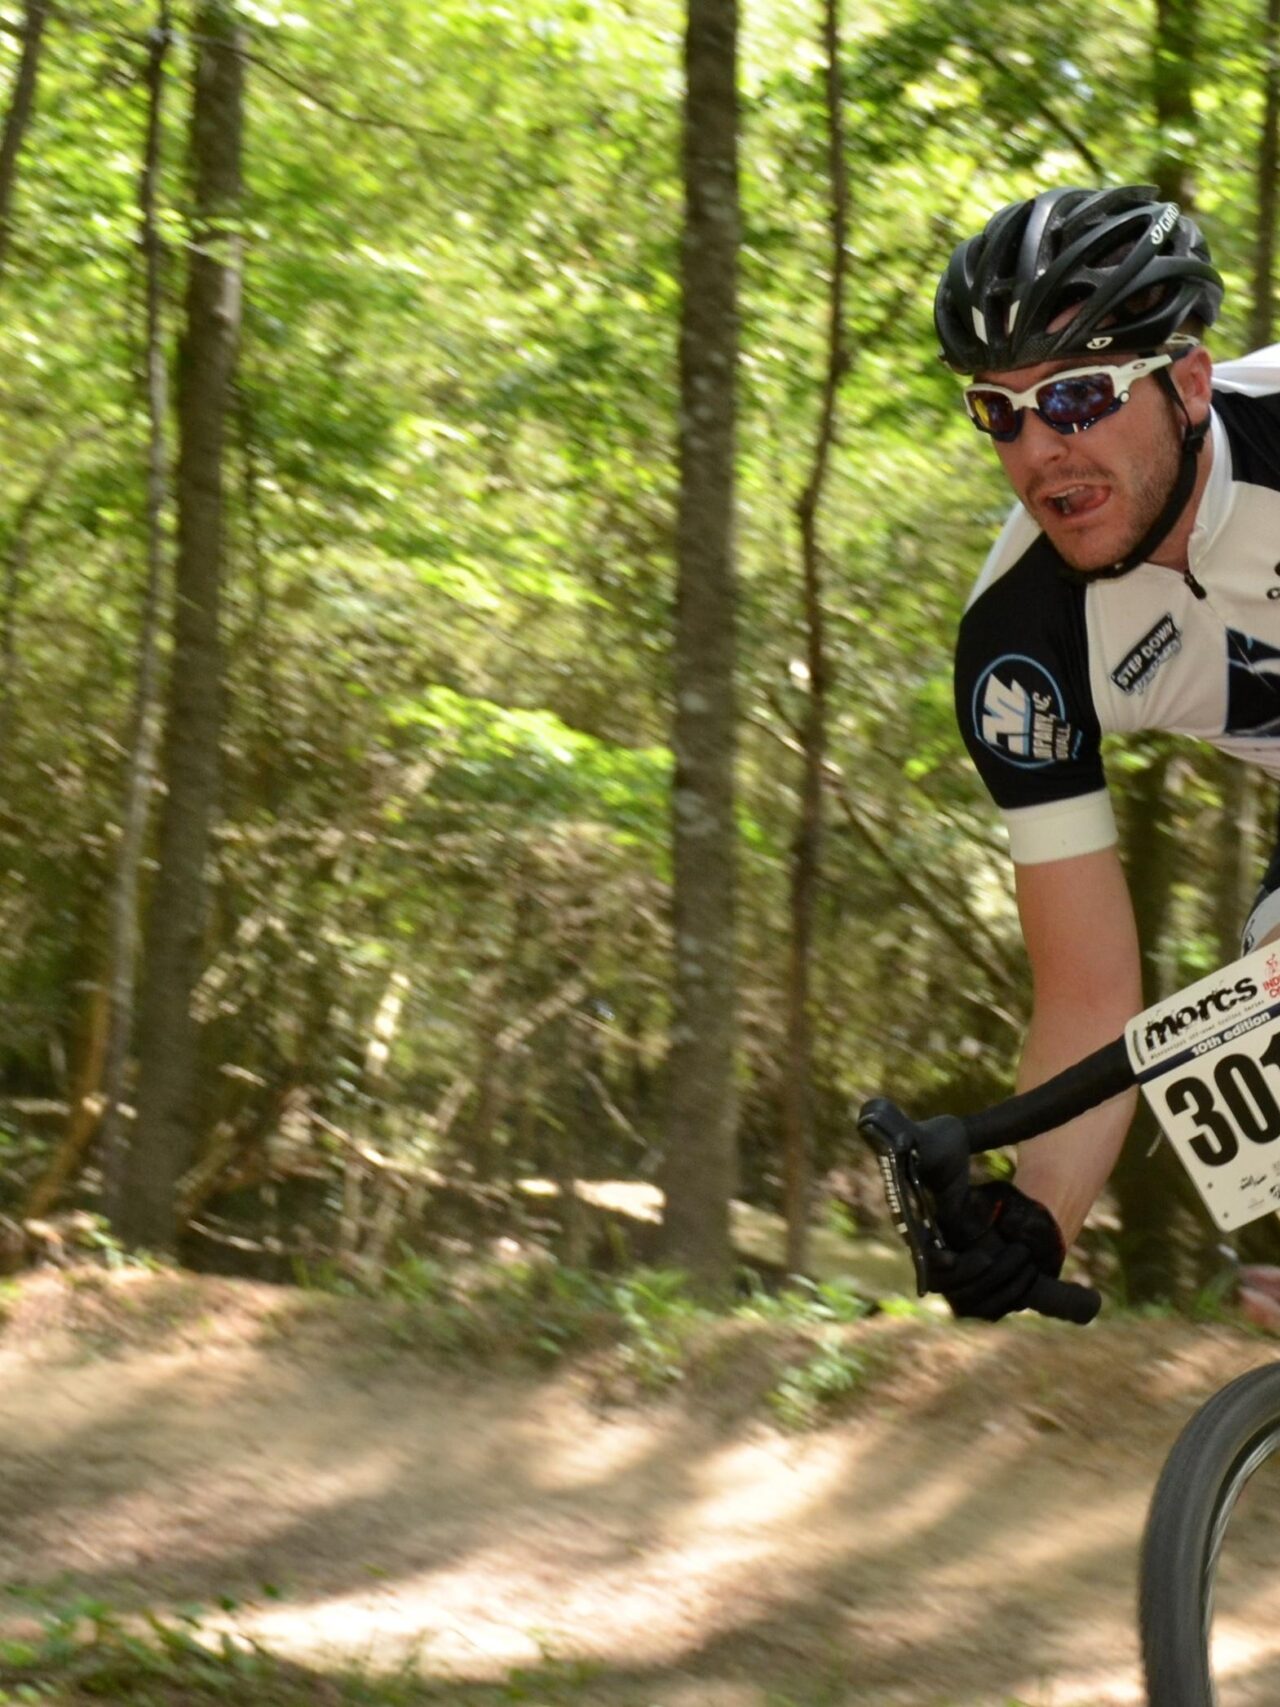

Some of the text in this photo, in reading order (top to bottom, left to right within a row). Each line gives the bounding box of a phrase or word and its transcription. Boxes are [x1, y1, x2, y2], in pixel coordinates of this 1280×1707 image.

[1117, 652, 1143, 686] STEP
[1145, 977, 1258, 1050] morcs
[1191, 1011, 1271, 1056] 10th edition
